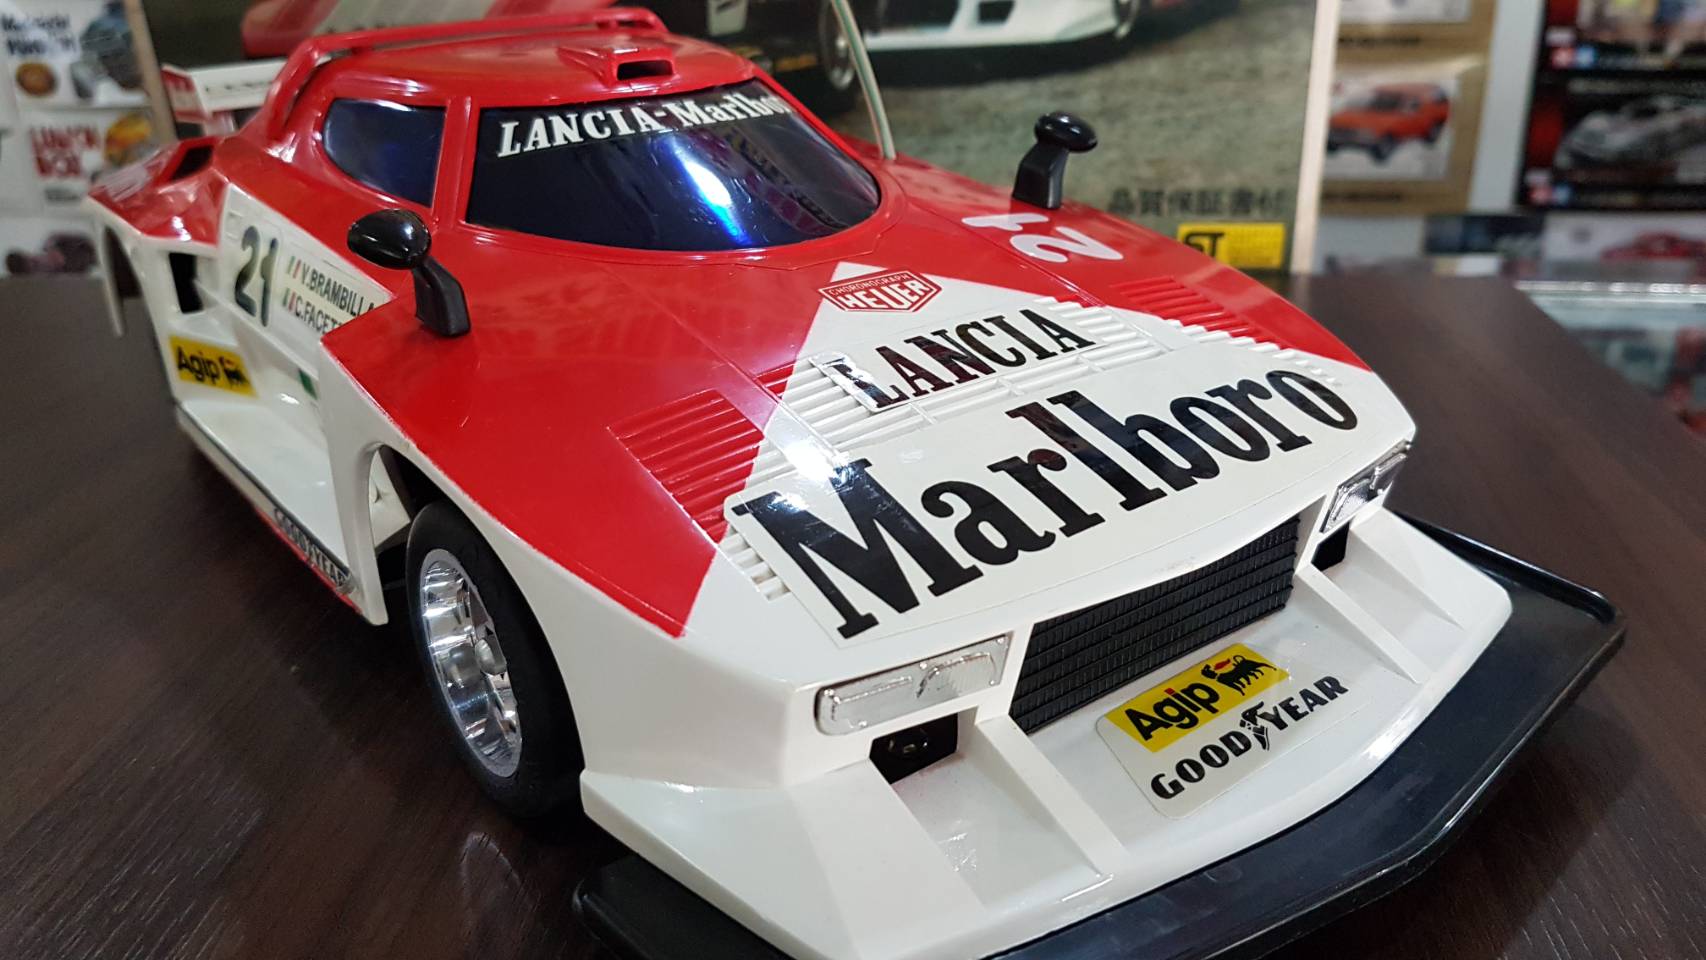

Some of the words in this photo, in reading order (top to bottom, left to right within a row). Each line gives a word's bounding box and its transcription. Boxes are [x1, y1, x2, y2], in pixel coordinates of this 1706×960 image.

[234, 225, 279, 327] 21
[837, 280, 930, 309] HEUER
[294, 296, 343, 336] C.FACET
[177, 346, 221, 384] Agip
[822, 309, 1096, 408] LANCIA
[731, 369, 1359, 641] Marlboro
[1124, 682, 1221, 742] Agip
